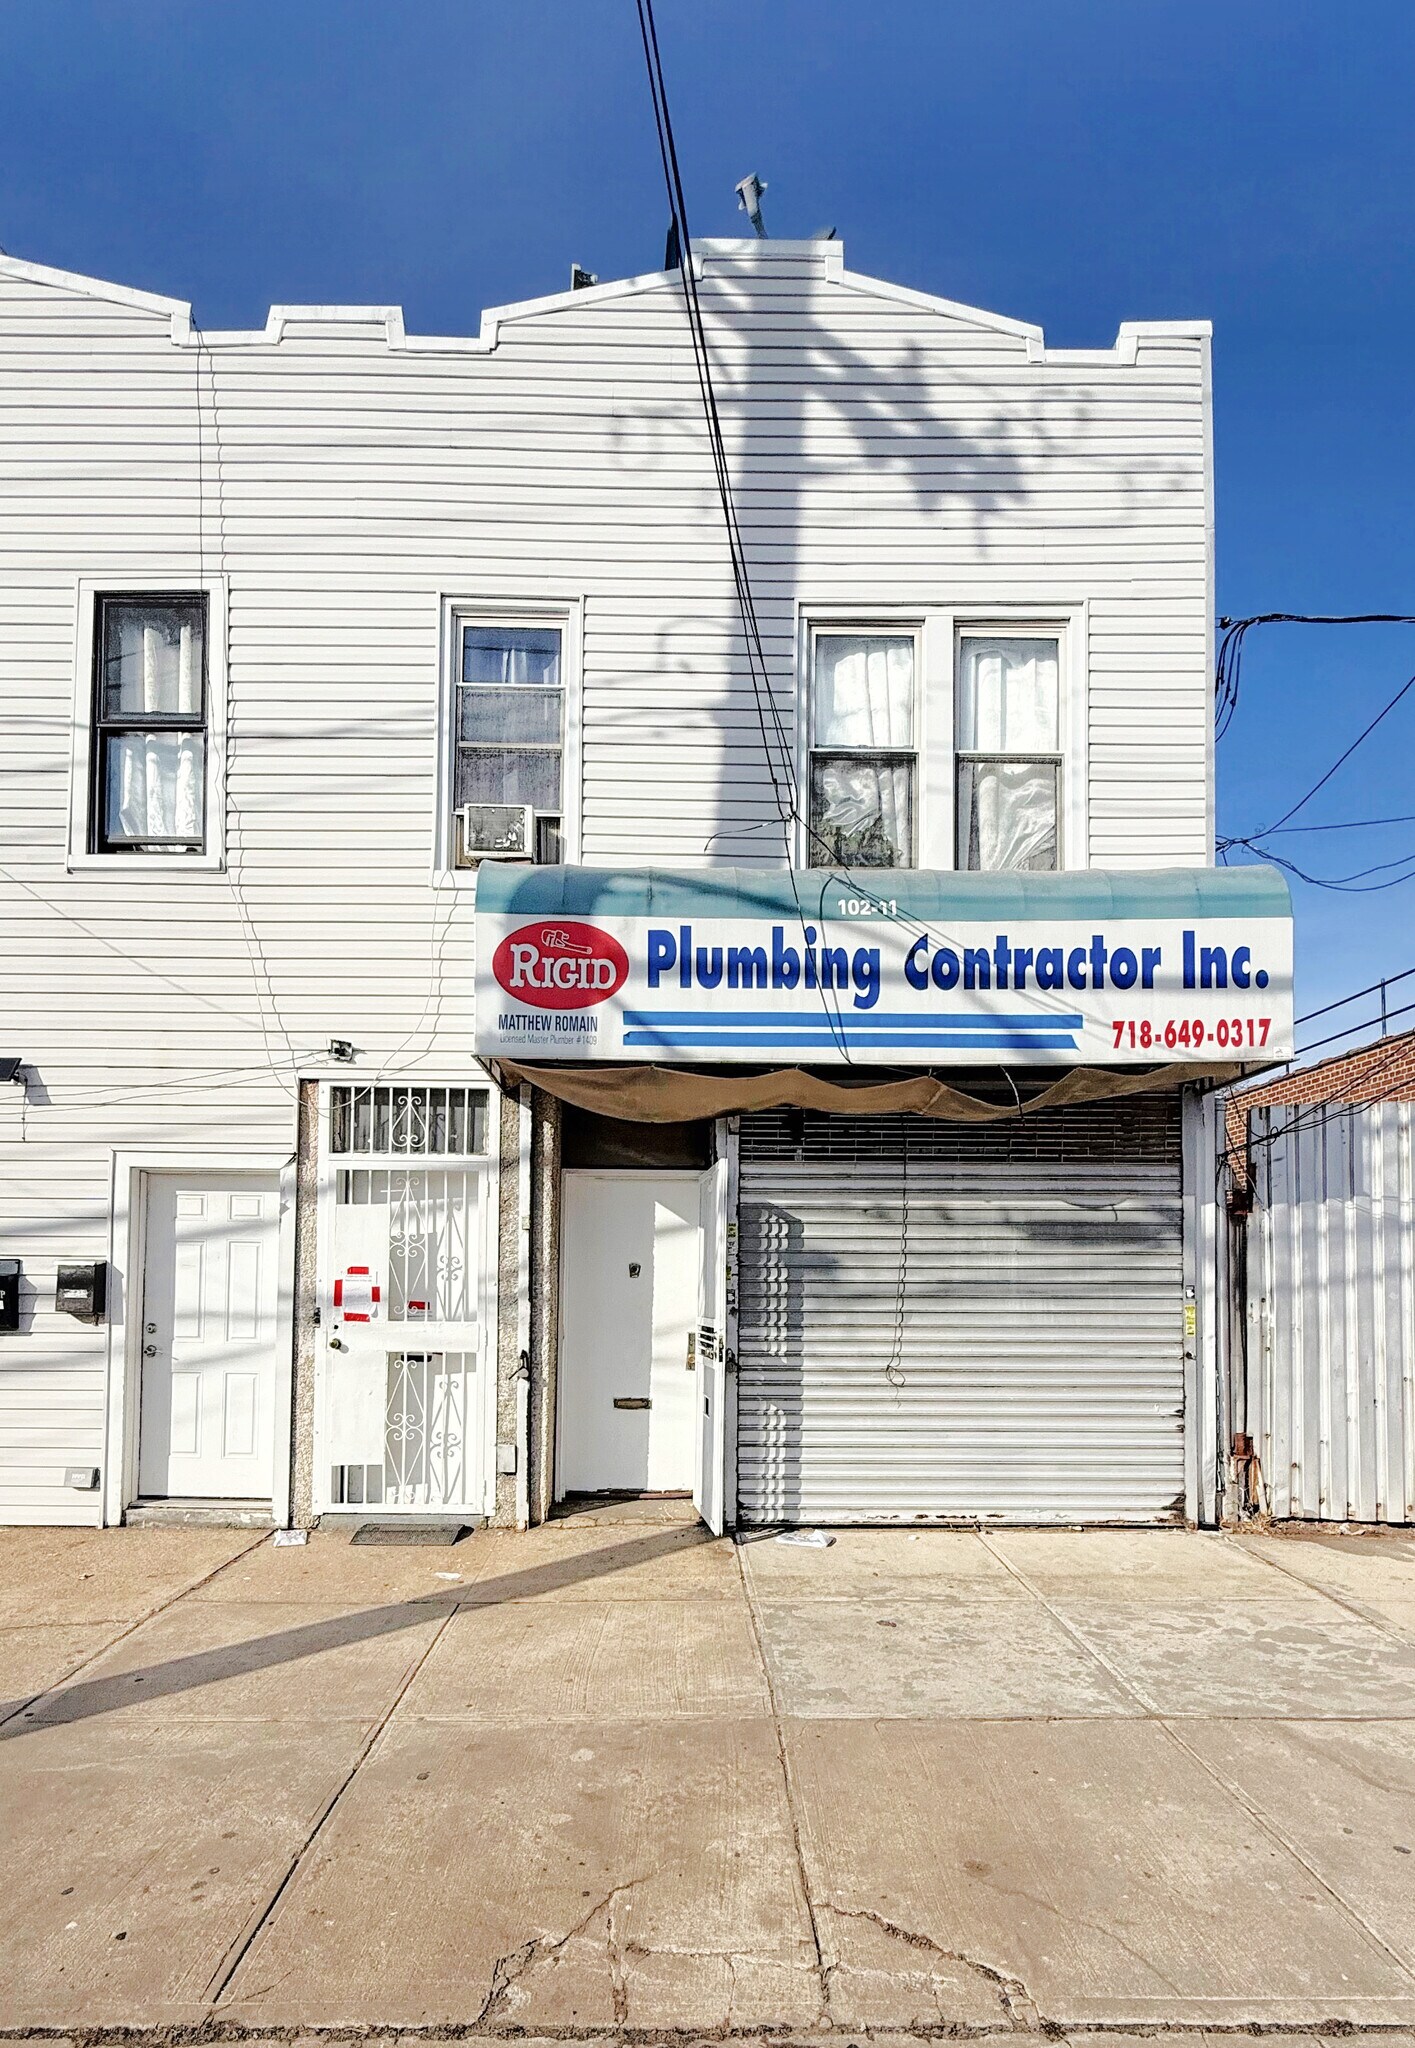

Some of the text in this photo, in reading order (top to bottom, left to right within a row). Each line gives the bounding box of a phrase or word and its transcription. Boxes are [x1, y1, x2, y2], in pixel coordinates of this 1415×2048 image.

[838, 899, 897, 916] 102-11
[509, 943, 617, 989] RIGID
[648, 926, 1269, 1009] Plumbing Contractor Inc.
[498, 1014, 598, 1032] MATTHEW ROMAIN
[1112, 1019, 1271, 1048] 718-649-0317
[500, 1034, 526, 1044] Licensed
[527, 1034, 549, 1044] Master
[550, 1034, 574, 1045] Plumber
